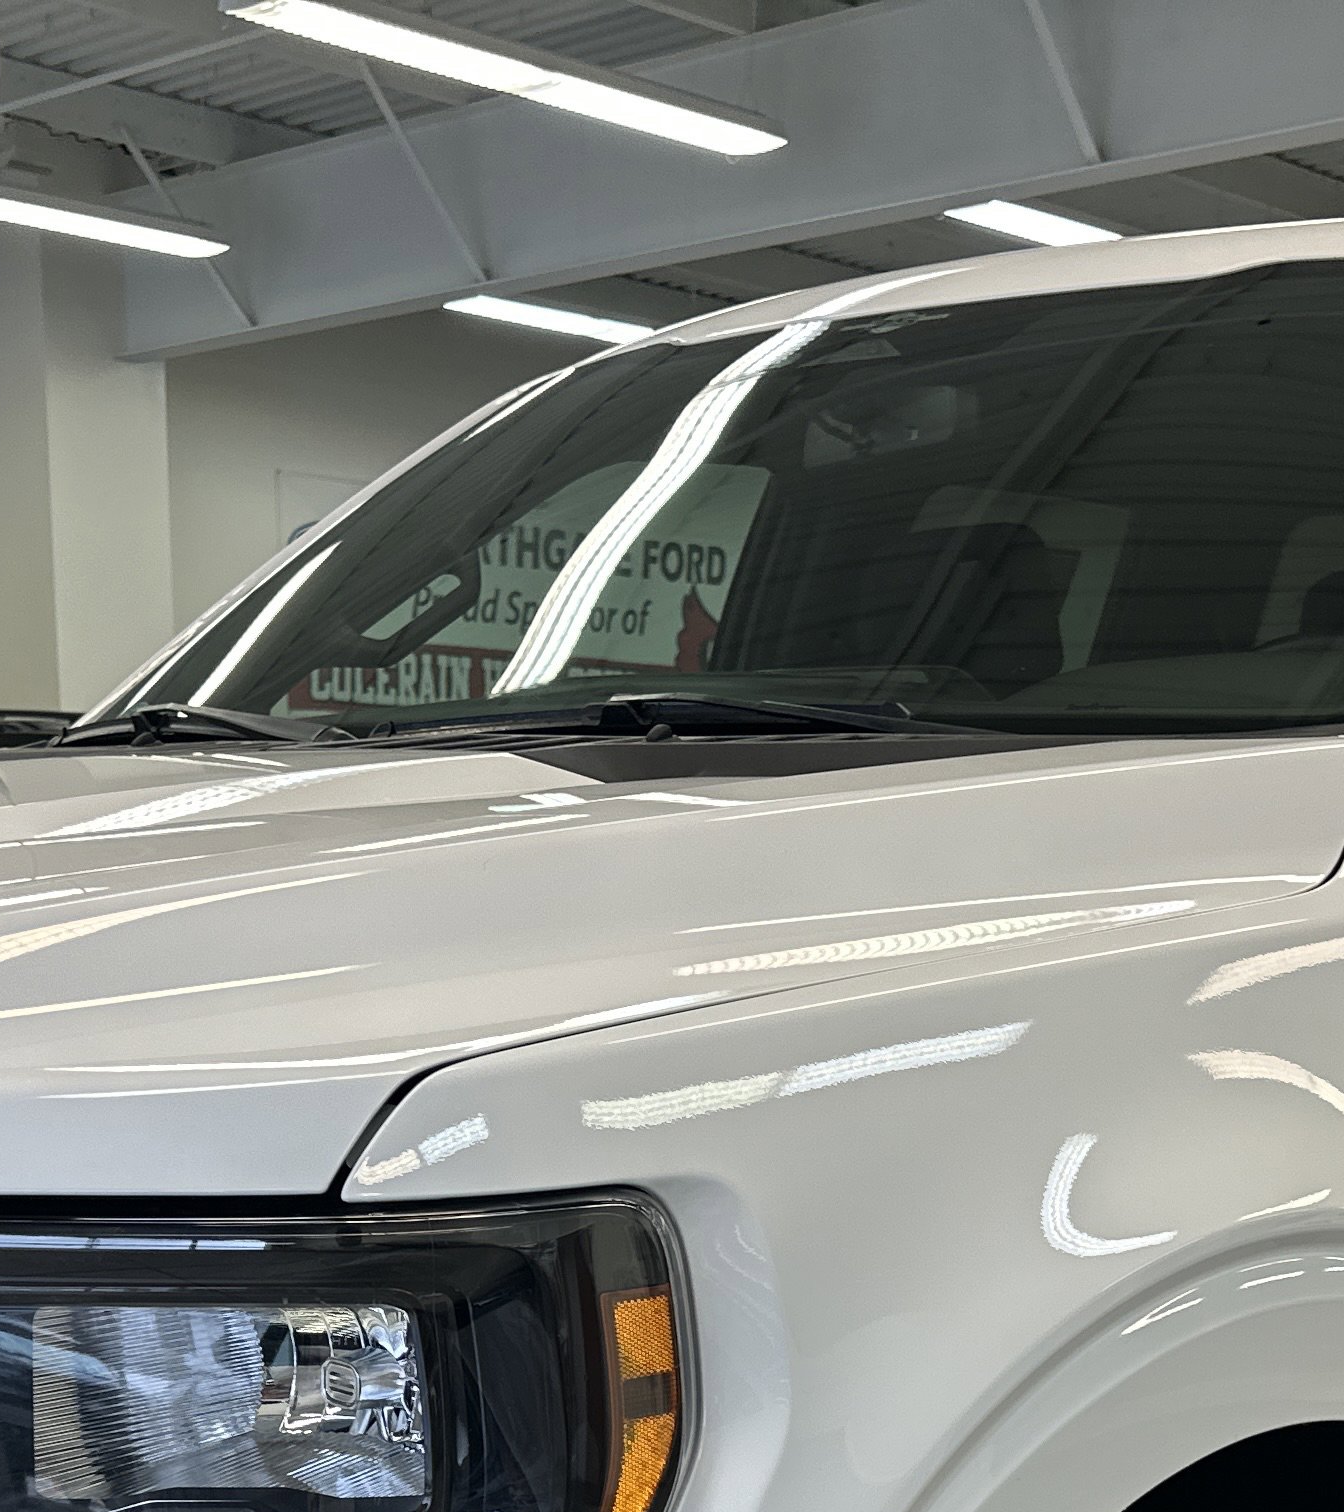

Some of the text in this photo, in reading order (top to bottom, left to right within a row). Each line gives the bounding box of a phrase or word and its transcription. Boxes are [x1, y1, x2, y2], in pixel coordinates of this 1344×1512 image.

[642, 539, 727, 586] FORD
[505, 590, 618, 637] Spor
[621, 600, 652, 637] of
